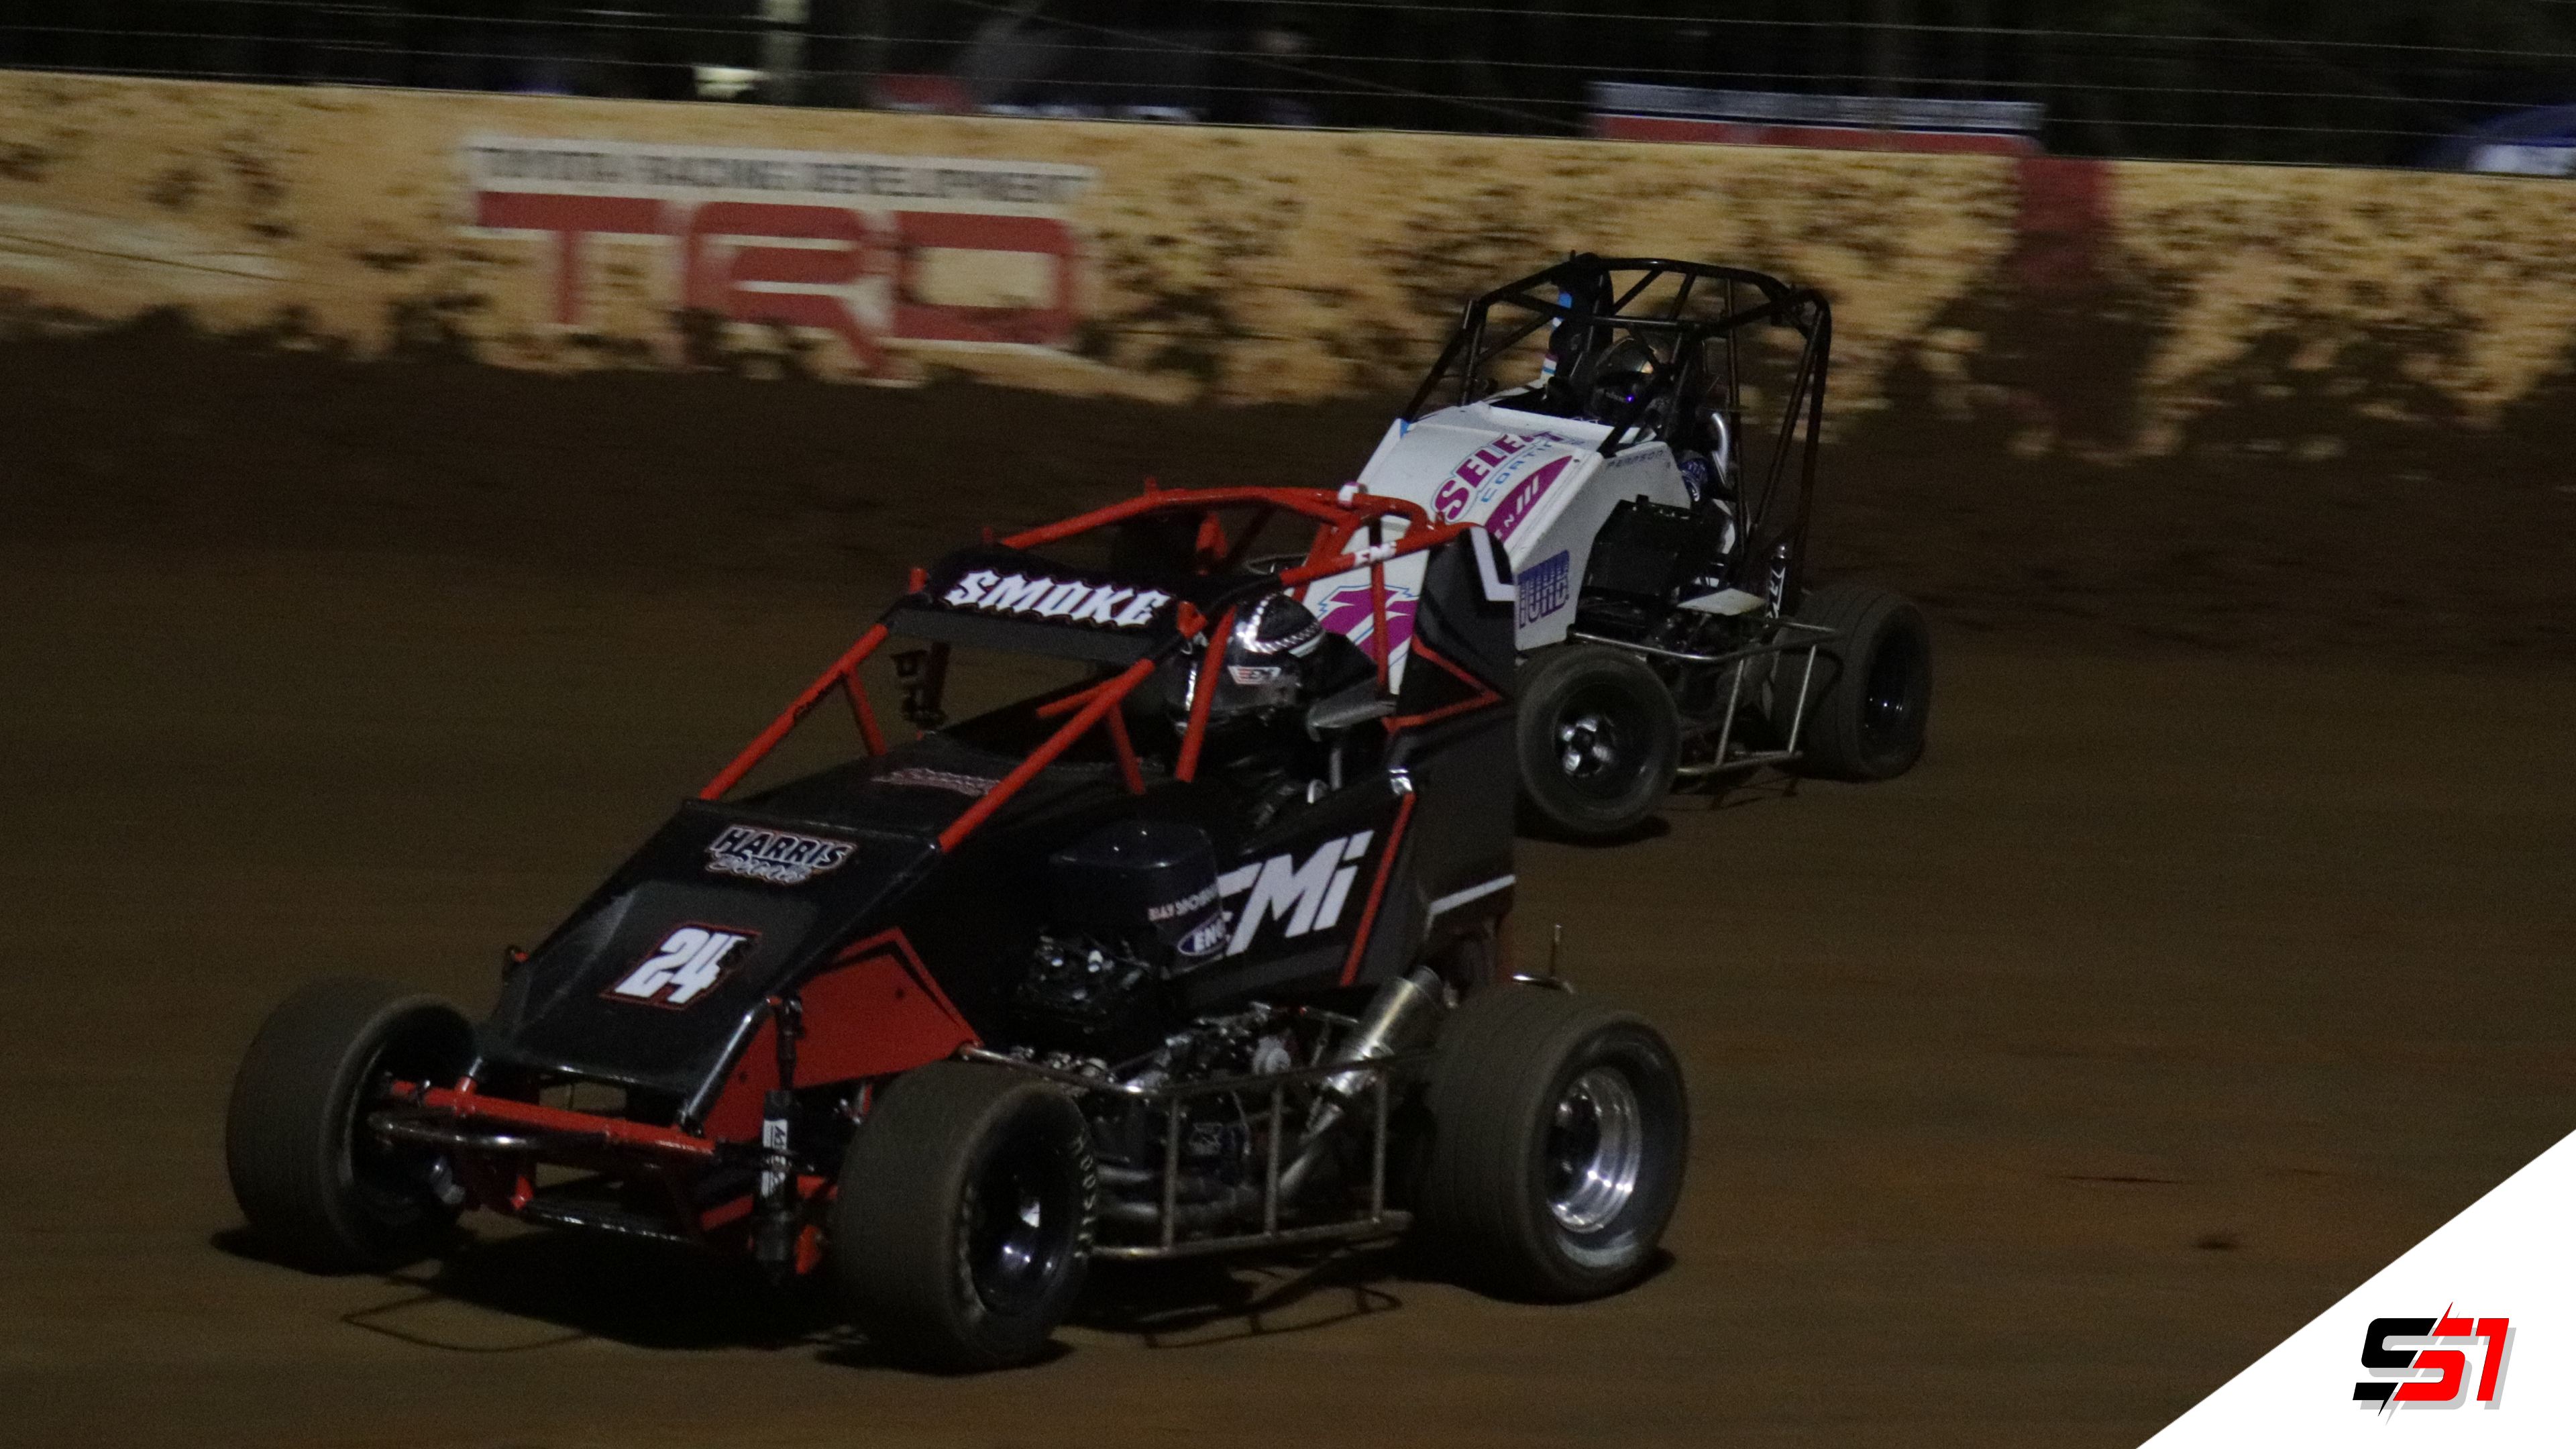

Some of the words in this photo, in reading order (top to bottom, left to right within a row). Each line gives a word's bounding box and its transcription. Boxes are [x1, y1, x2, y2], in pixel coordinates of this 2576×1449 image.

[474, 191, 1077, 380] TRD
[943, 569, 1173, 627] SMOKE
[711, 825, 855, 867] HARRIS
[614, 928, 746, 1004] 24
